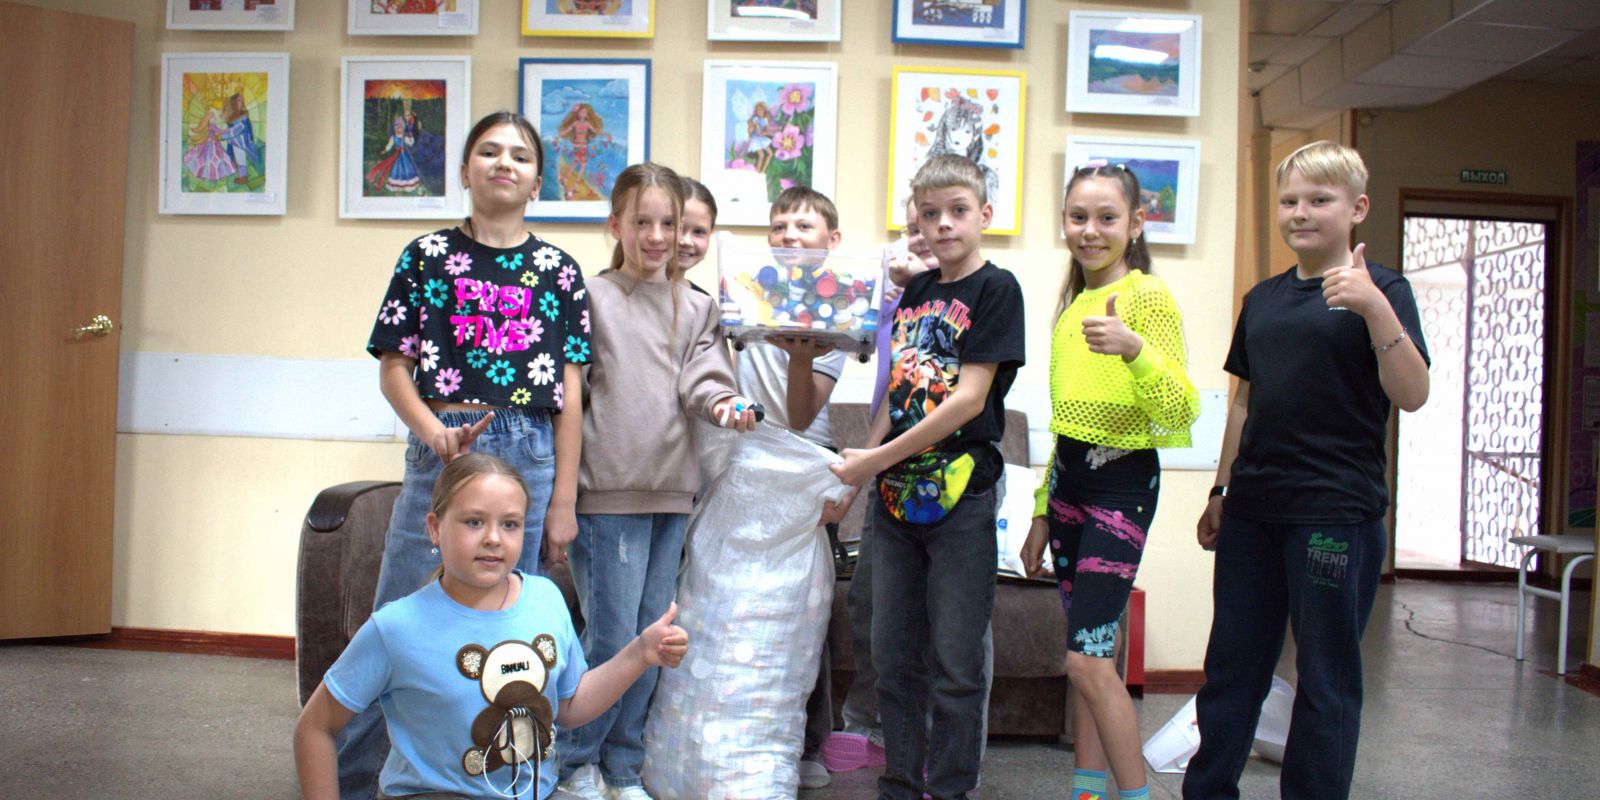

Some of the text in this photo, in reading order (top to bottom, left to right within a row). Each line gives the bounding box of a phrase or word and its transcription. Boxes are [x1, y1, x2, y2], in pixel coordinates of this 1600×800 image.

[1462, 170, 1505, 184] ВЫХОД
[453, 277, 533, 320] POSI
[449, 314, 530, 352] TIVE
[1306, 547, 1349, 567] TREND
